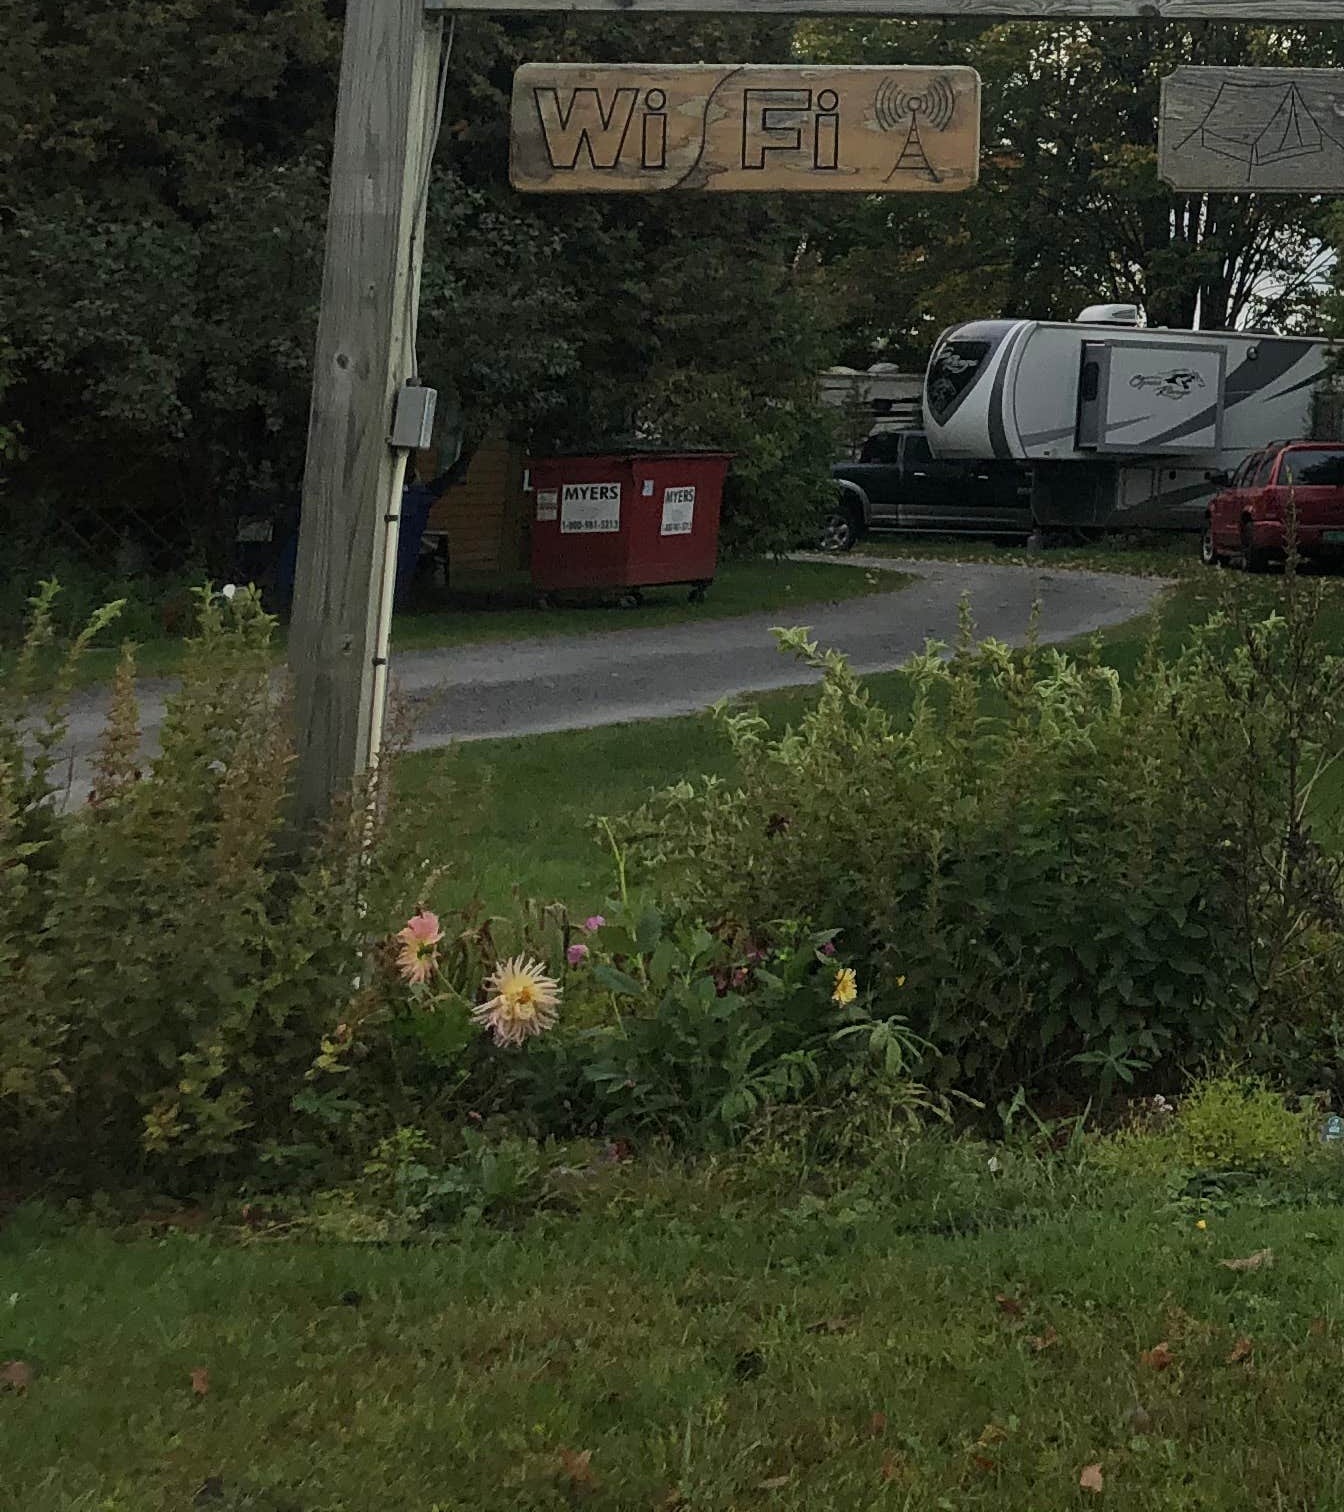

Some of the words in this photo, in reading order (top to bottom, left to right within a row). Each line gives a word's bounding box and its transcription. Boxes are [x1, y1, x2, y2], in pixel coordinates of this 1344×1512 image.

[533, 87, 667, 170] Wi
[741, 88, 840, 170] Fi
[564, 486, 618, 501] MYERS
[665, 489, 694, 503] MYERS
